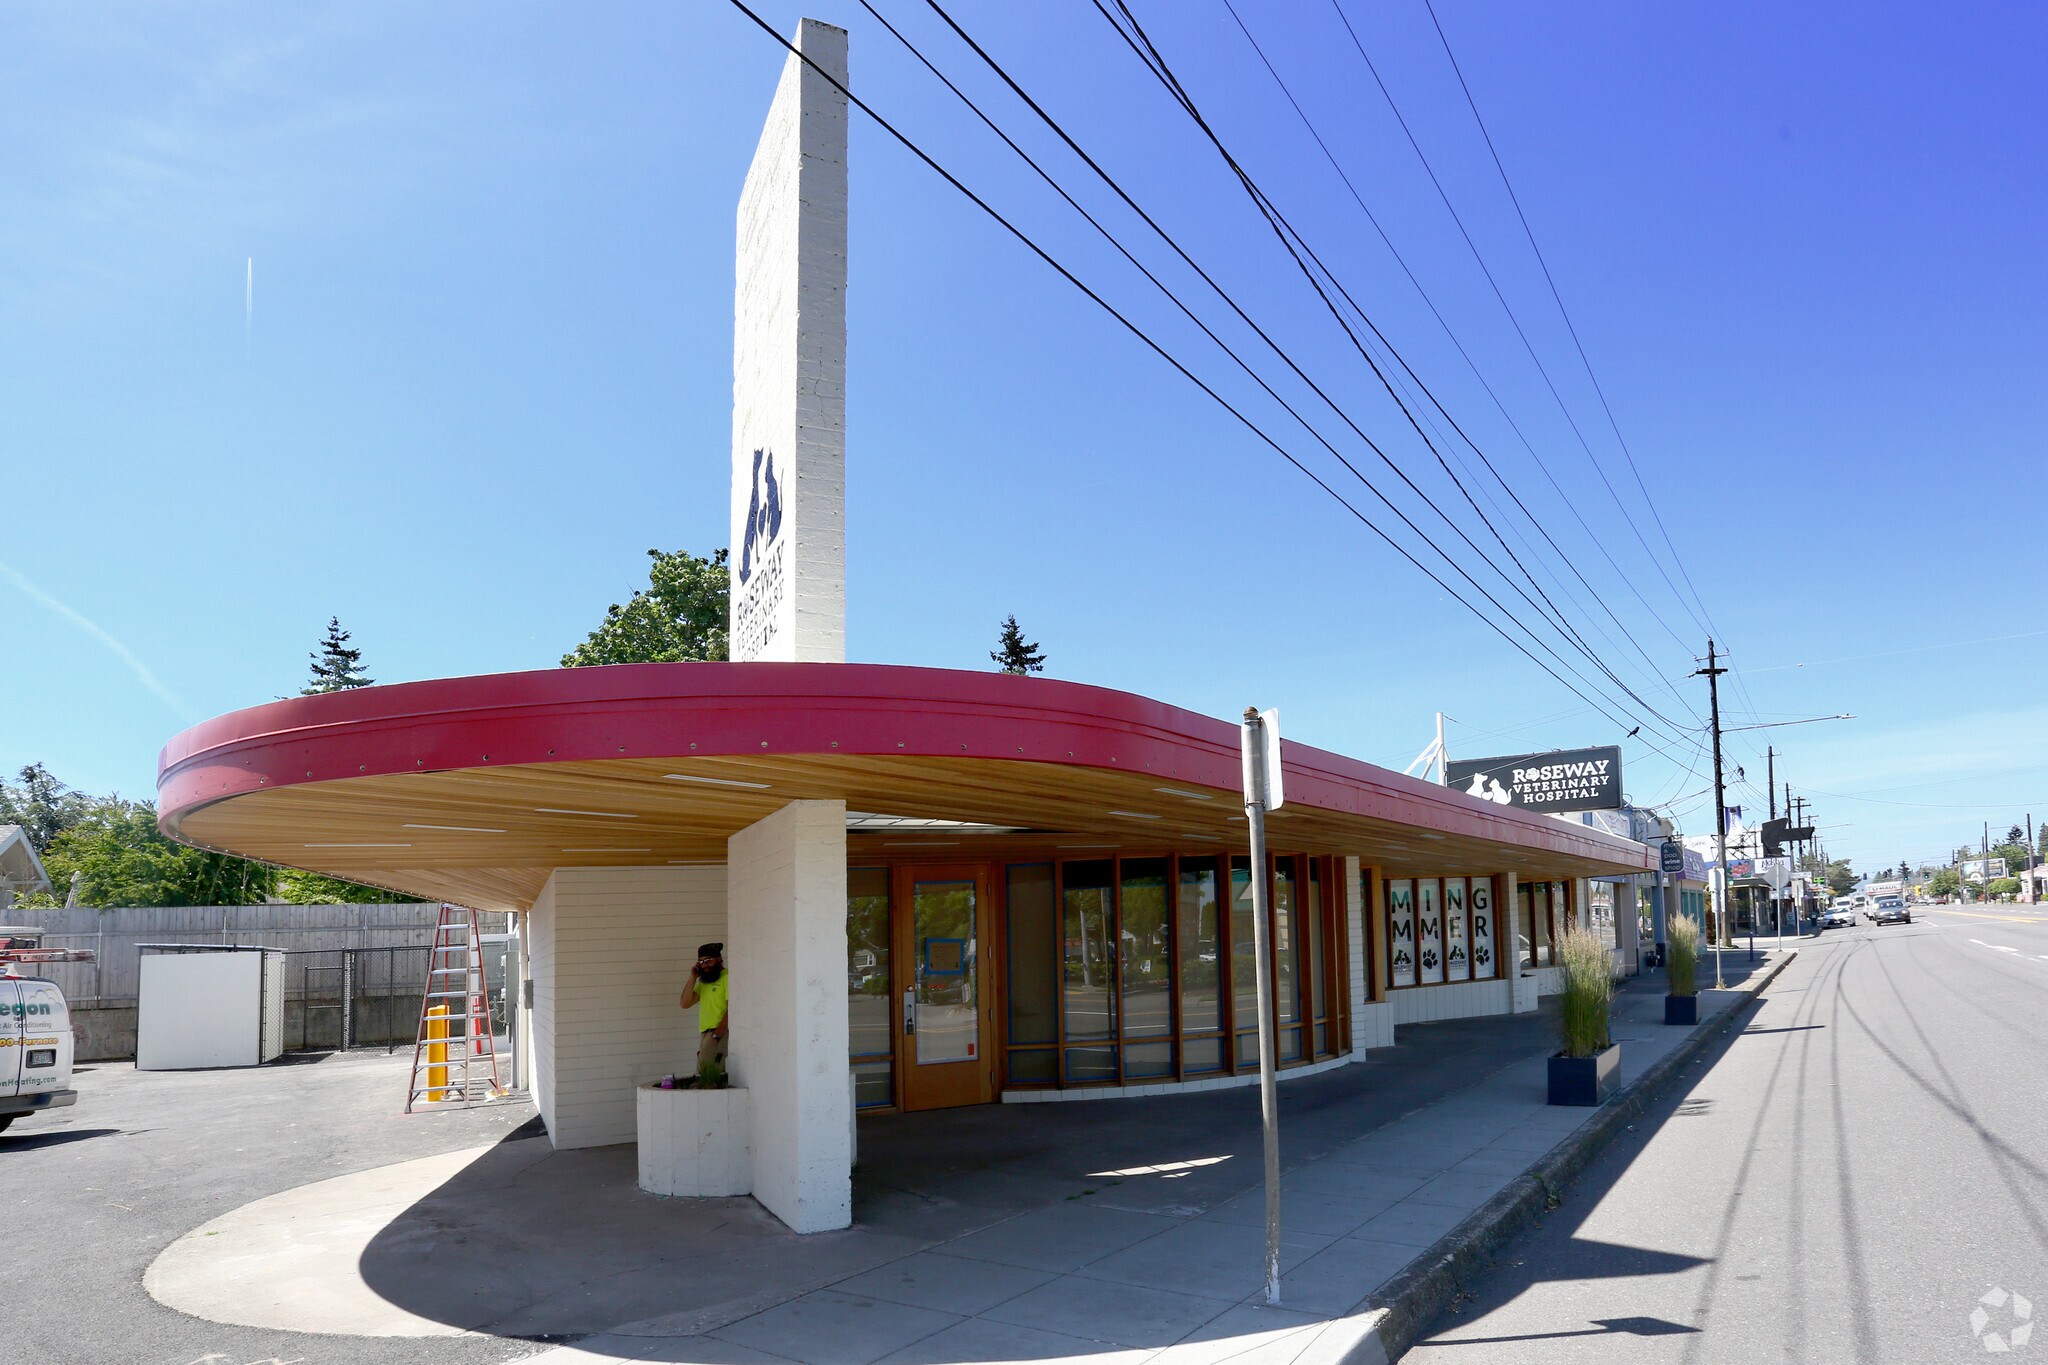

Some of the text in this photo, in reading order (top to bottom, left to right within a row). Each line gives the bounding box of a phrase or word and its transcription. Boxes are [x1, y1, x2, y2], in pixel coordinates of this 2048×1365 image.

[737, 539, 784, 632] ROSEWAY
[737, 578, 784, 652] VETERINARY
[1512, 760, 1609, 783] ROSEWAY
[1513, 776, 1609, 793] VETERINARY
[1523, 787, 1599, 804] HOSPITAL
[0, 1076, 57, 1087] nHeating.com
